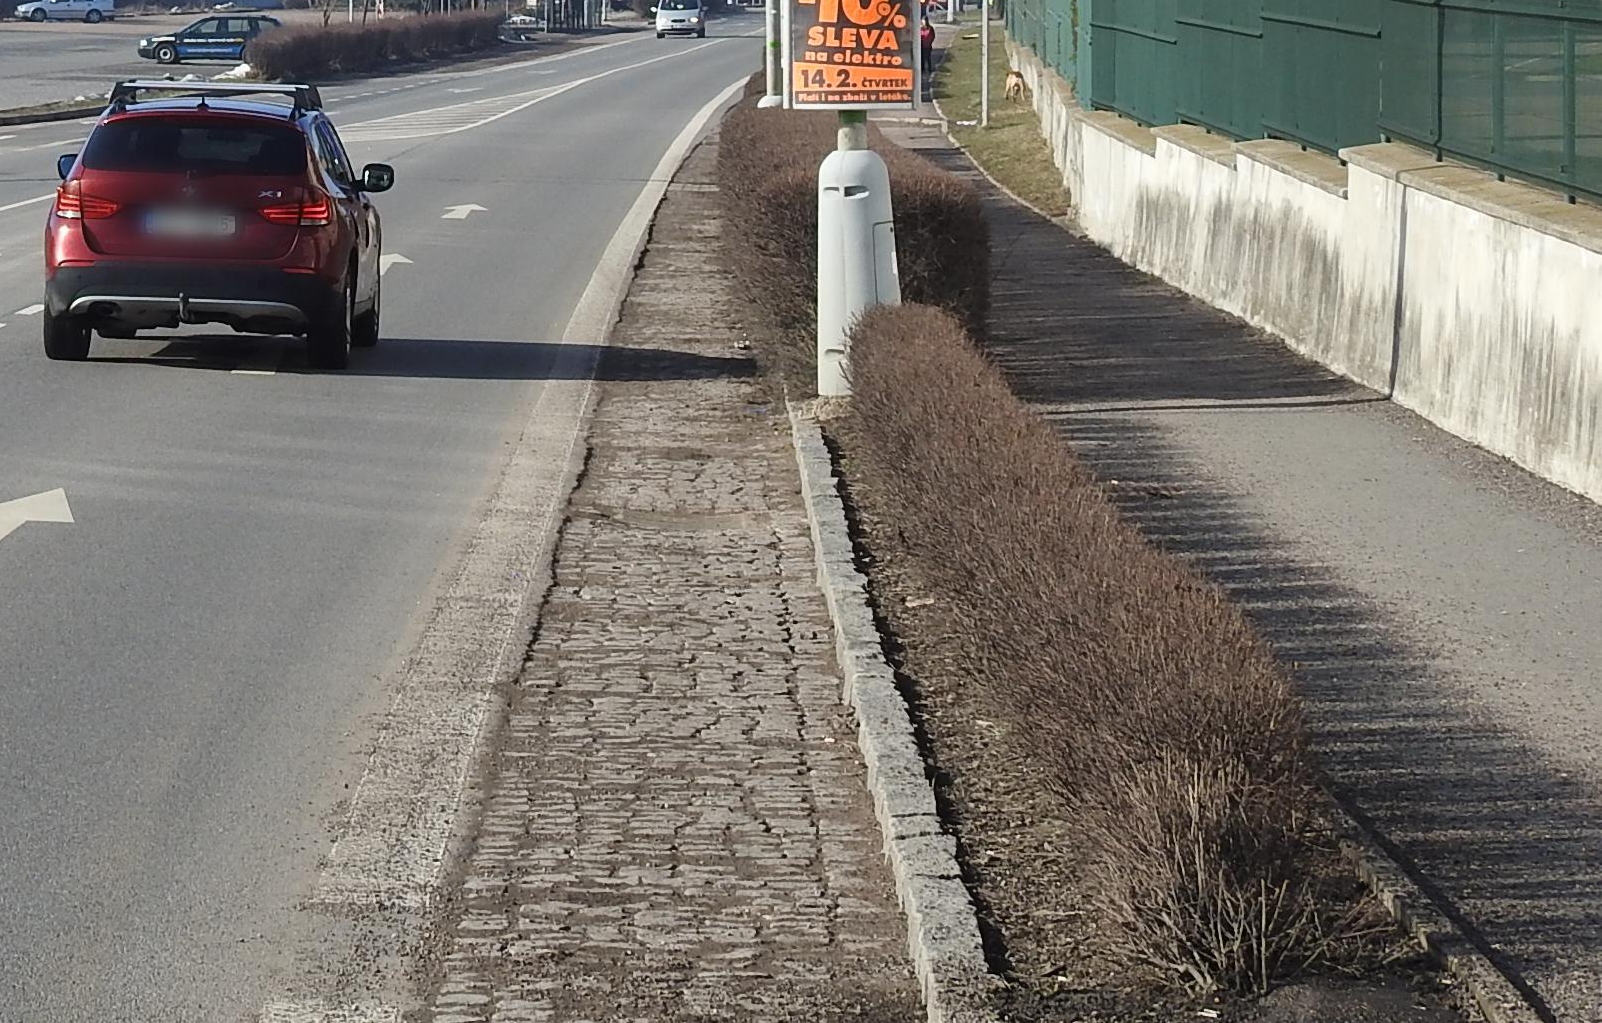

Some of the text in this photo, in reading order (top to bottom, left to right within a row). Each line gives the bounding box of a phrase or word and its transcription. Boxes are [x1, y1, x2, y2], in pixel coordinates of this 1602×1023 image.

[807, 26, 898, 50] SLEVA
[805, 50, 902, 66] na elektro
[862, 76, 908, 87] ČTVRTEK
